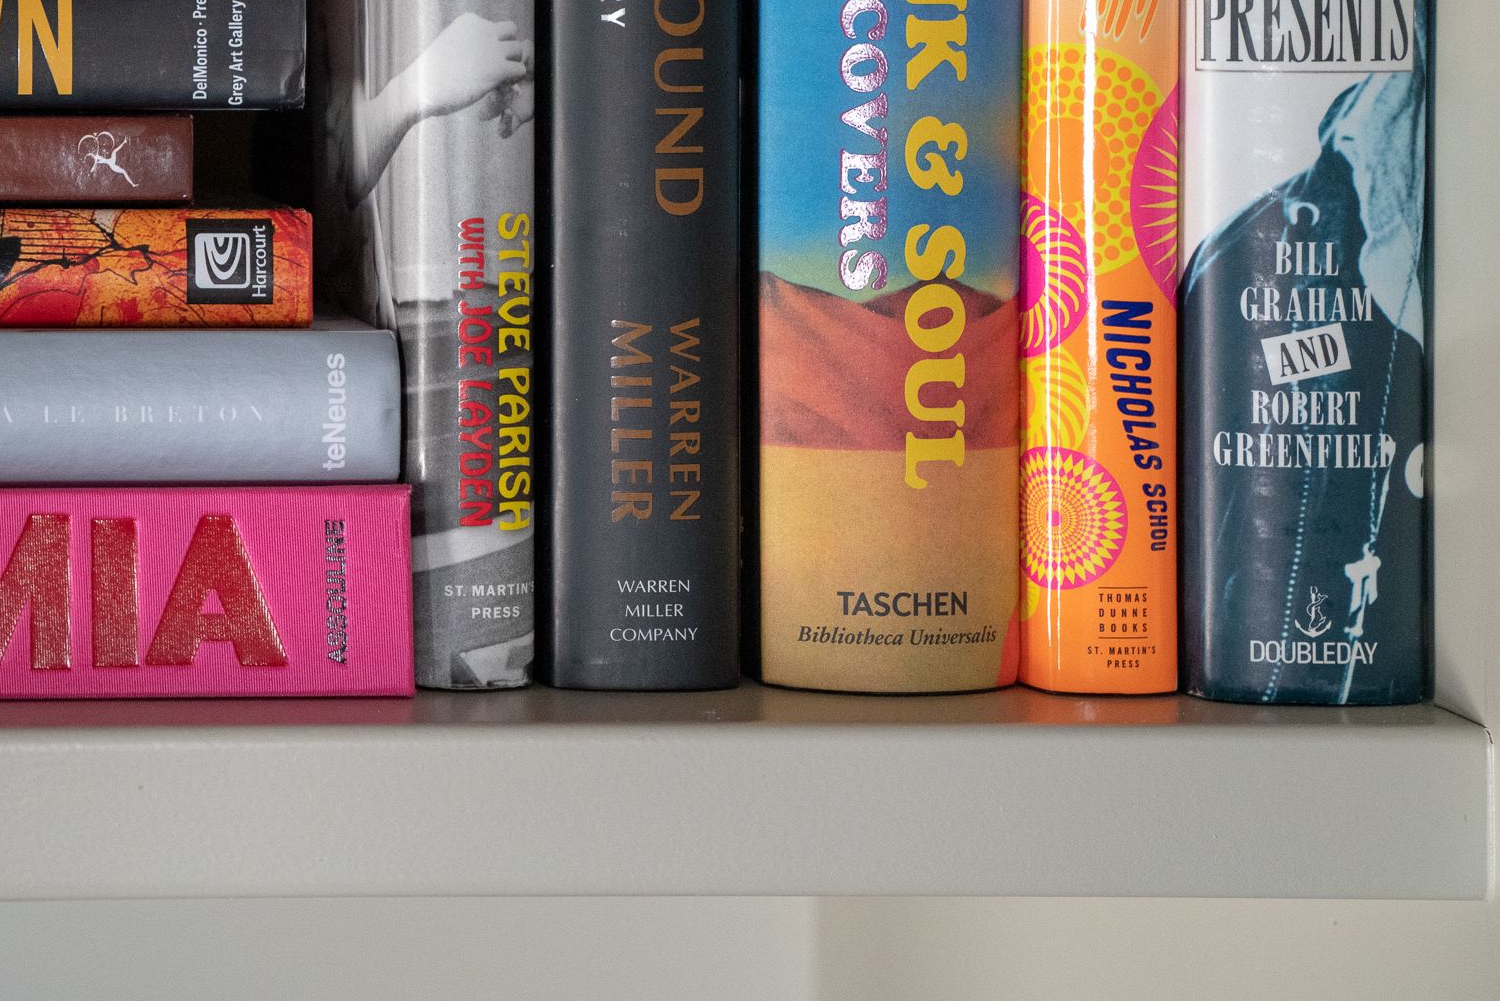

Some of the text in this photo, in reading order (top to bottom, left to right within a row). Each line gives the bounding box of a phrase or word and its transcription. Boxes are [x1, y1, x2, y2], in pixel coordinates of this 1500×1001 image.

[192, 28, 208, 100] DelMonico
[228, 50, 244, 72] Art
[227, 75, 248, 106] Grey
[904, 115, 969, 197] &
[251, 225, 267, 298] Harcourt
[1274, 241, 1340, 277] BILL
[1240, 286, 1373, 322] GRAHAM
[904, 223, 967, 490] SOUL
[1279, 332, 1339, 378] AND
[457, 217, 494, 528] WITH JOE LAYDEN
[497, 212, 532, 532] STEVE PARISH
[43, 404, 86, 424] LE
[114, 404, 264, 424] BRETON
[322, 352, 347, 471] teNeues
[610, 319, 654, 524] MILLER
[668, 317, 701, 521] WARREN
[1250, 390, 1361, 426] ROBERT
[1101, 300, 1169, 553] NICHOLAS SCHOU
[1212, 430, 1398, 470] GREENFIELD
[325, 519, 348, 665] ASSOULINE
[444, 584, 466, 597] ST.
[617, 579, 690, 594] WARREN
[1098, 593, 1148, 603] THOMAS
[471, 605, 521, 619] PRESS
[624, 603, 684, 618] MILLER
[836, 591, 968, 617] TASCHEN
[1098, 608, 1148, 618] DUNNE
[609, 627, 699, 642] COMPANY
[797, 625, 998, 647] Bibliotheca Universalis
[1098, 623, 1148, 633] BOOKS
[1087, 645, 1156, 655] ST. MARTIN'S
[1107, 659, 1140, 668] PRESS
[1250, 639, 1379, 665] DOUBLEDAY
